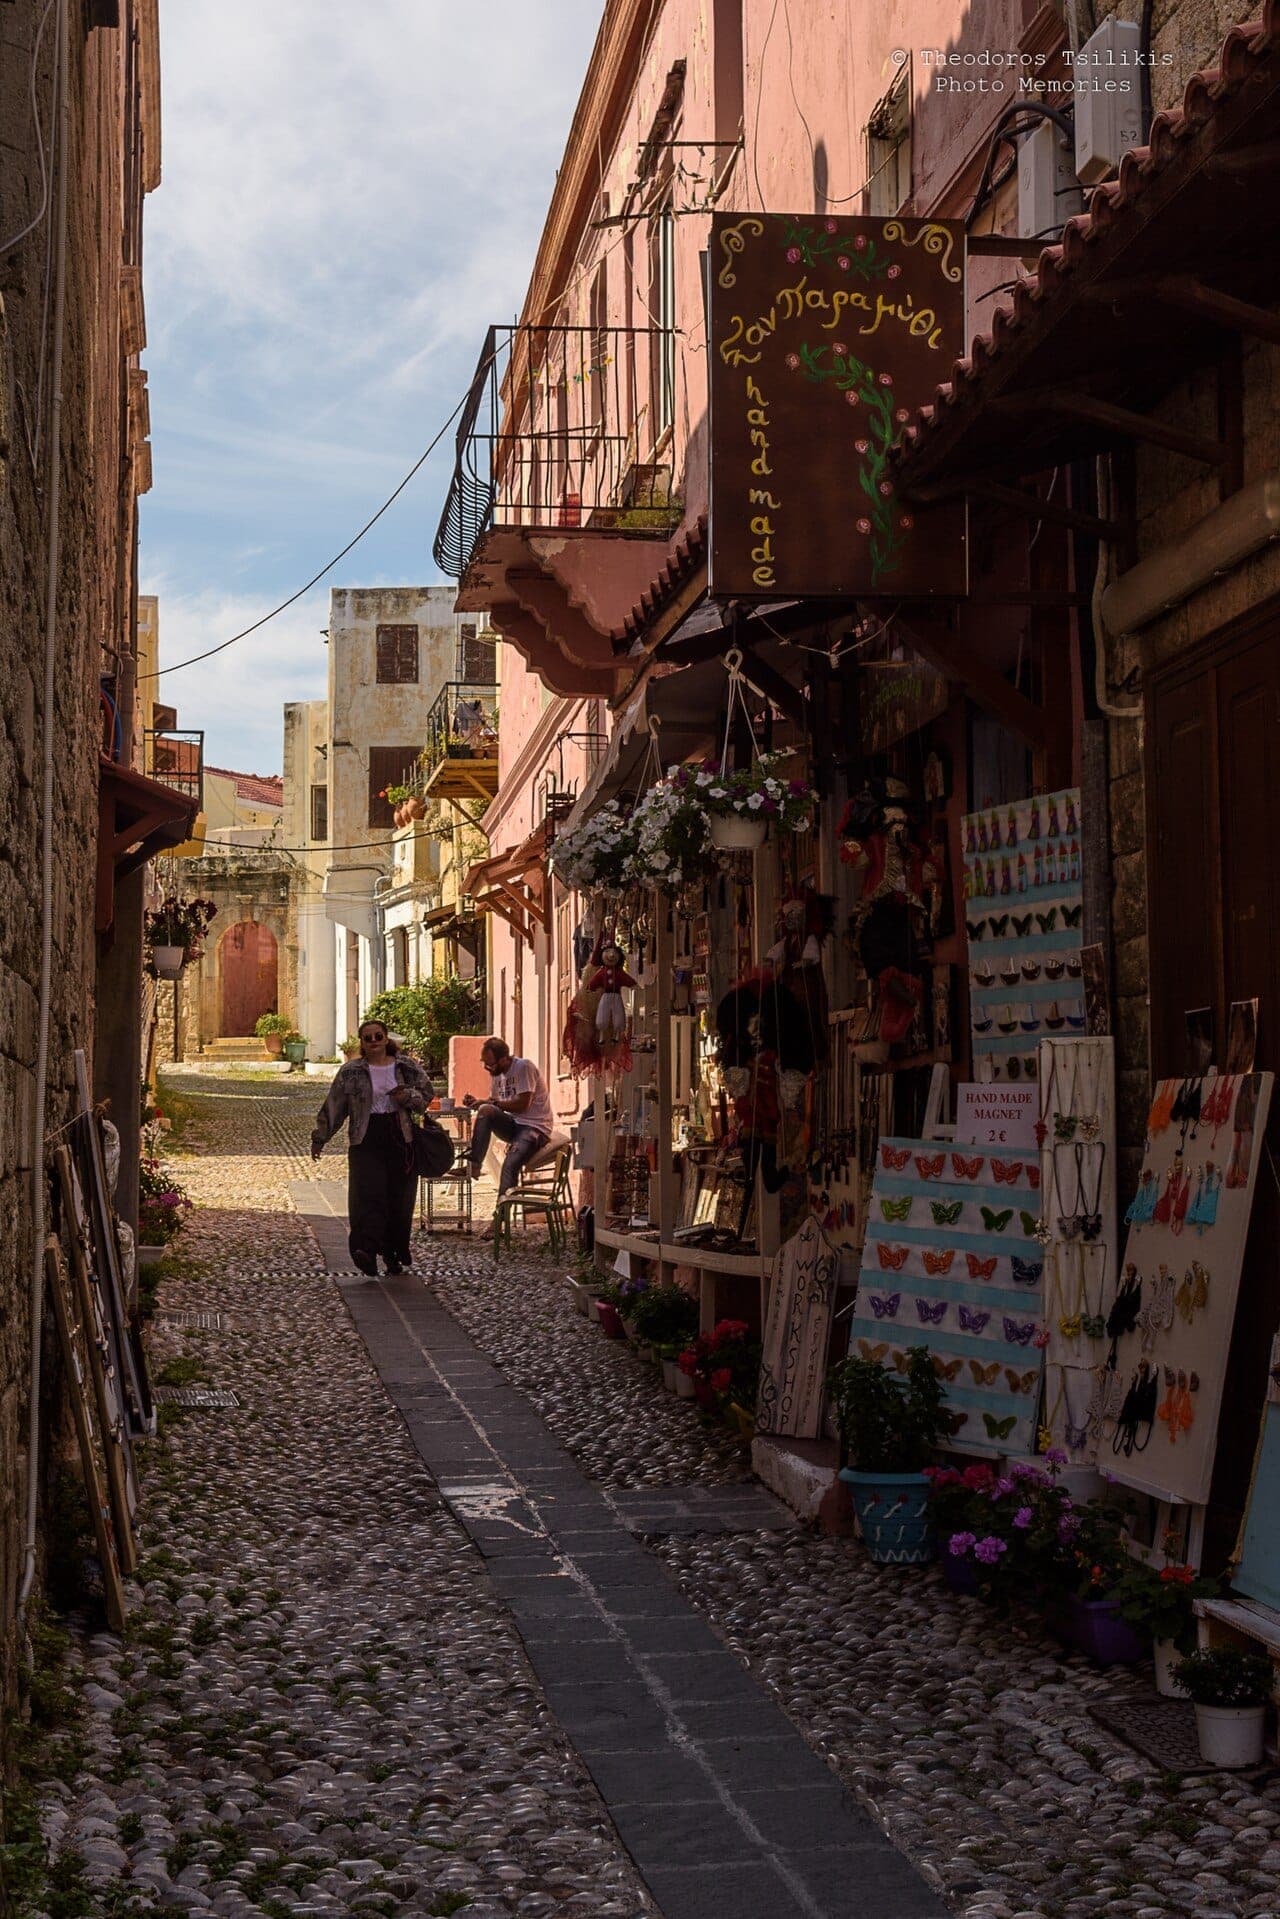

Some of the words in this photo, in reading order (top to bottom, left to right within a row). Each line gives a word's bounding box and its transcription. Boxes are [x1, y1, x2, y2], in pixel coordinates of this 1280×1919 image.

[745, 375, 773, 476] hand
[748, 488, 782, 588] made
[966, 1093, 997, 1104] HAND
[1000, 1093, 1033, 1104] MADE
[974, 1109, 1023, 1120] MAGNET
[781, 1259, 814, 1426] WORKSHOP
